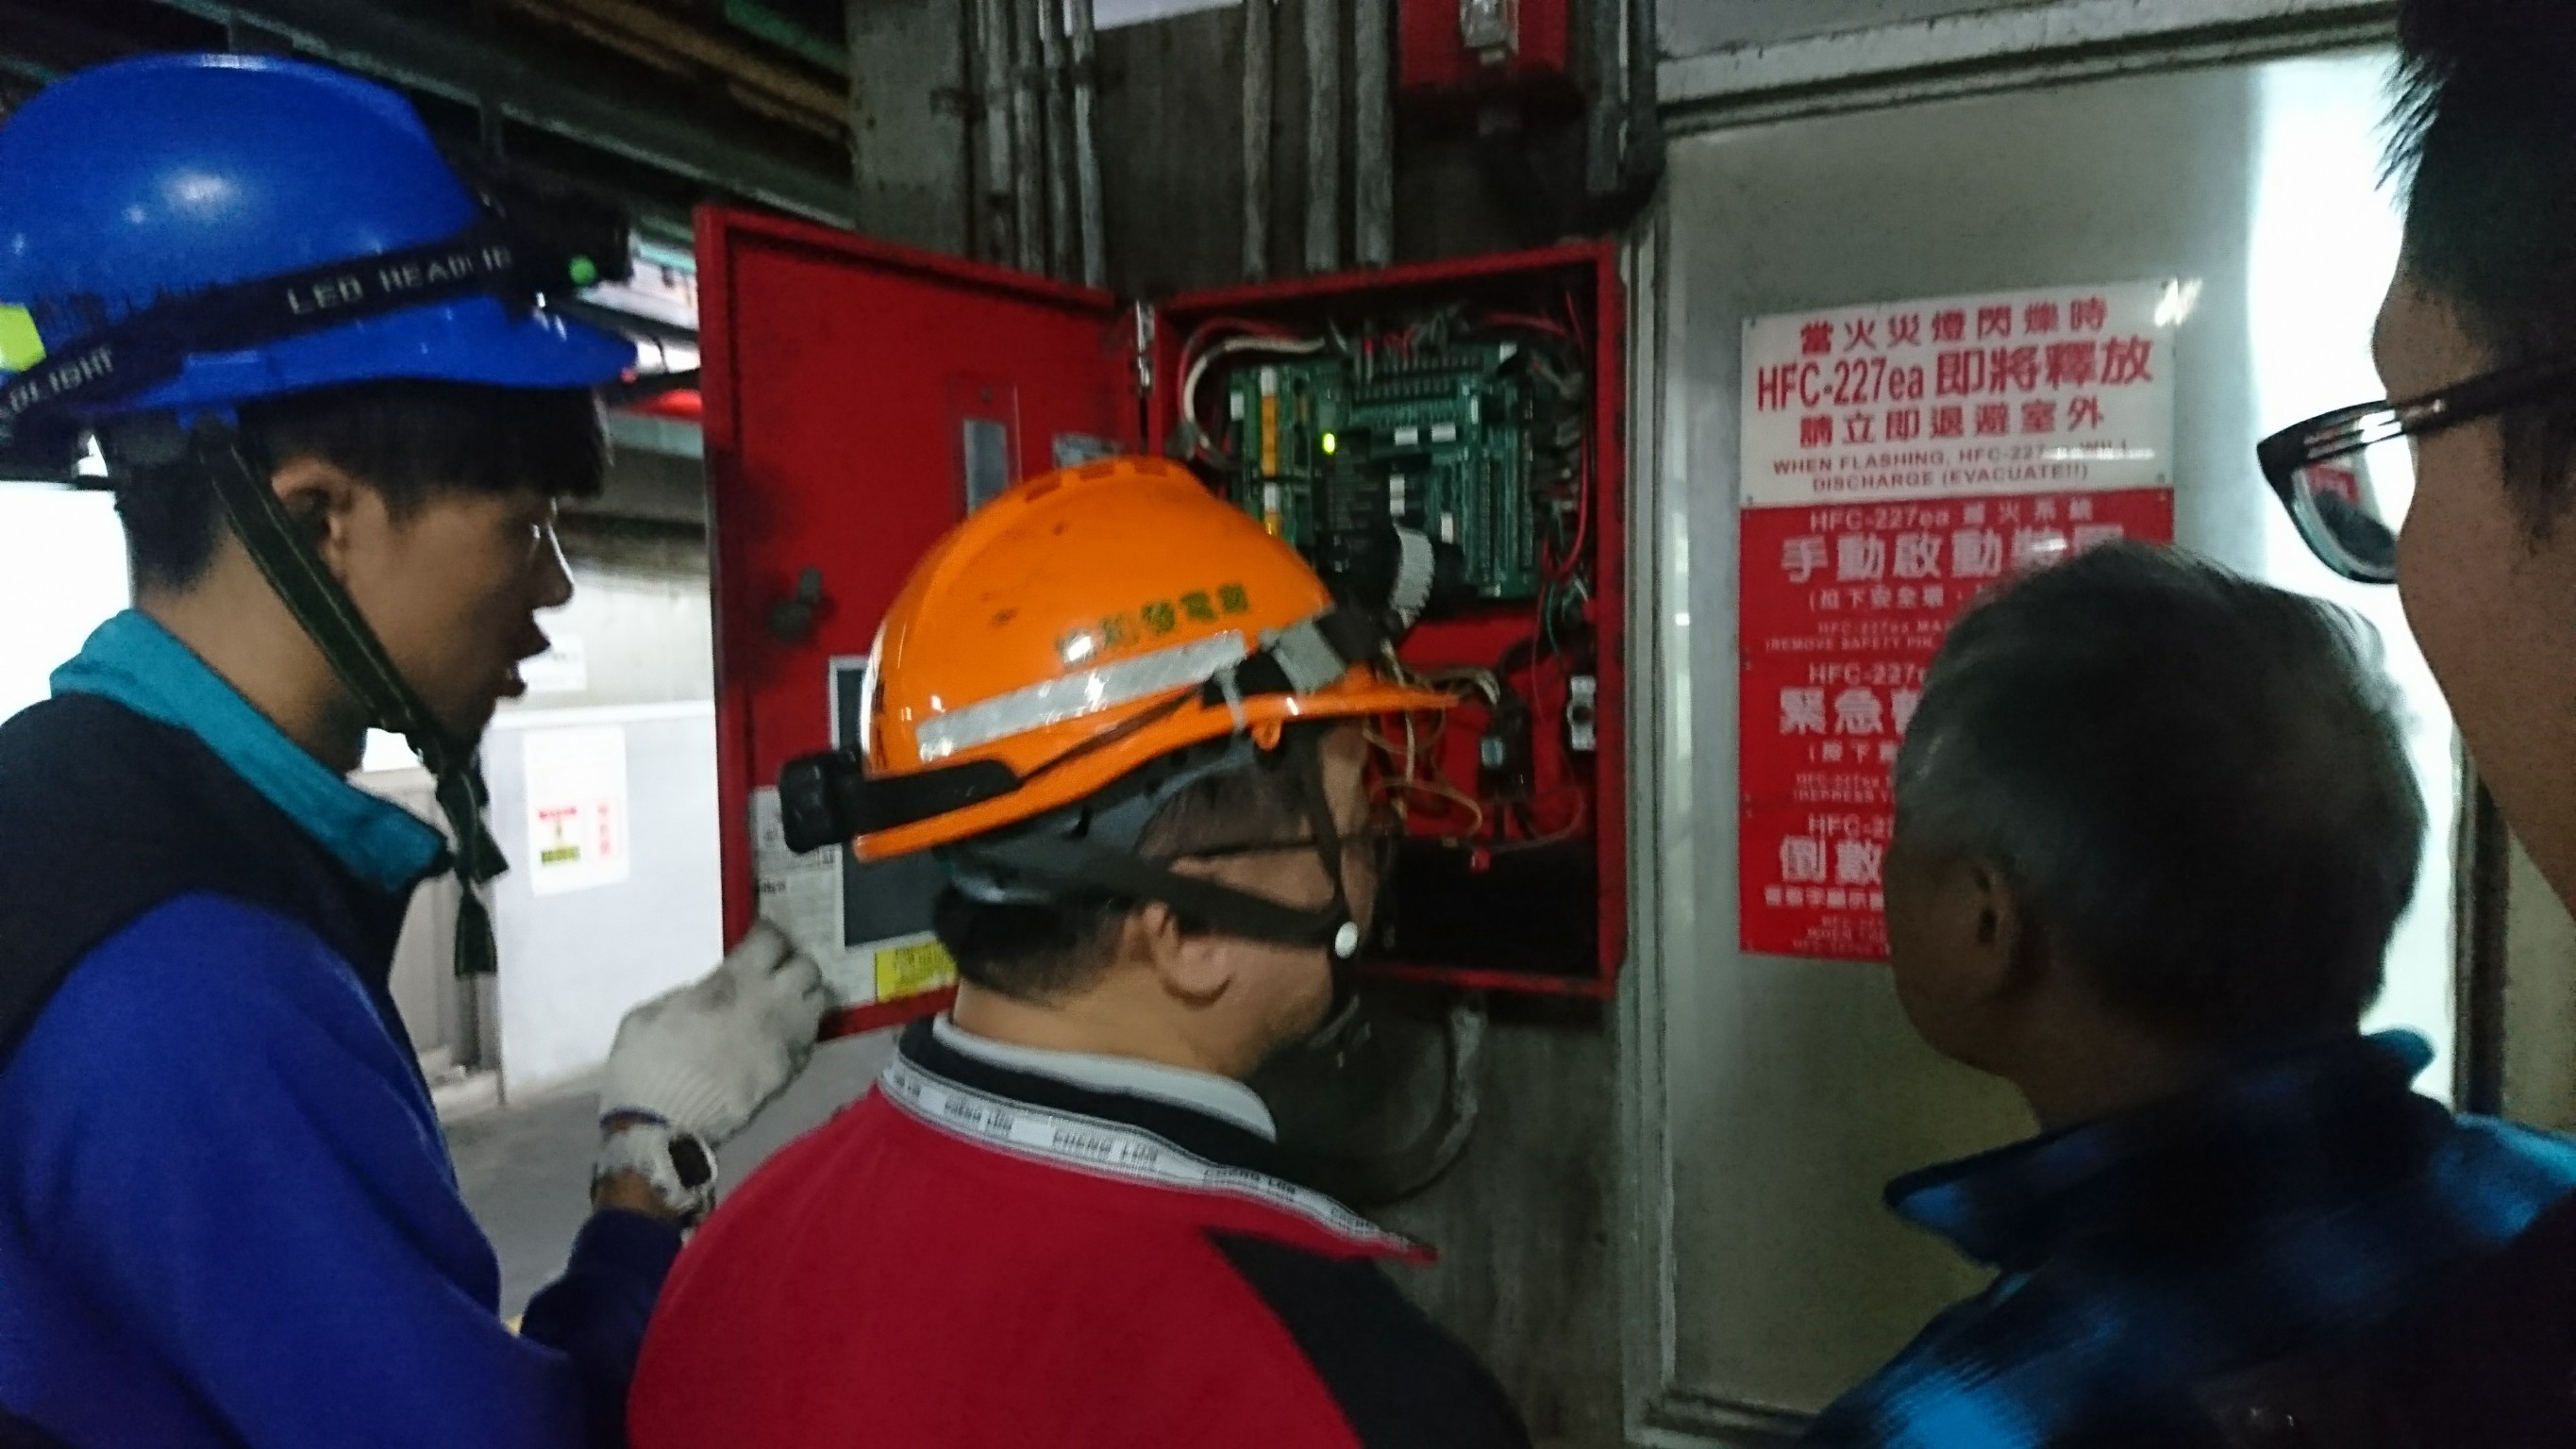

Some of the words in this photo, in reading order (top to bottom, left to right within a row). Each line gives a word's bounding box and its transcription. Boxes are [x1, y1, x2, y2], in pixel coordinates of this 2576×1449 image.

[287, 276, 362, 314] LED
[1758, 356, 1925, 410] HFC-227ea
[1937, 334, 2153, 396] 即將釋放
[1773, 458, 1832, 475] WHEN
[1813, 473, 1932, 492] DISCHARGE
[1810, 505, 1949, 533] HFC-227ea
